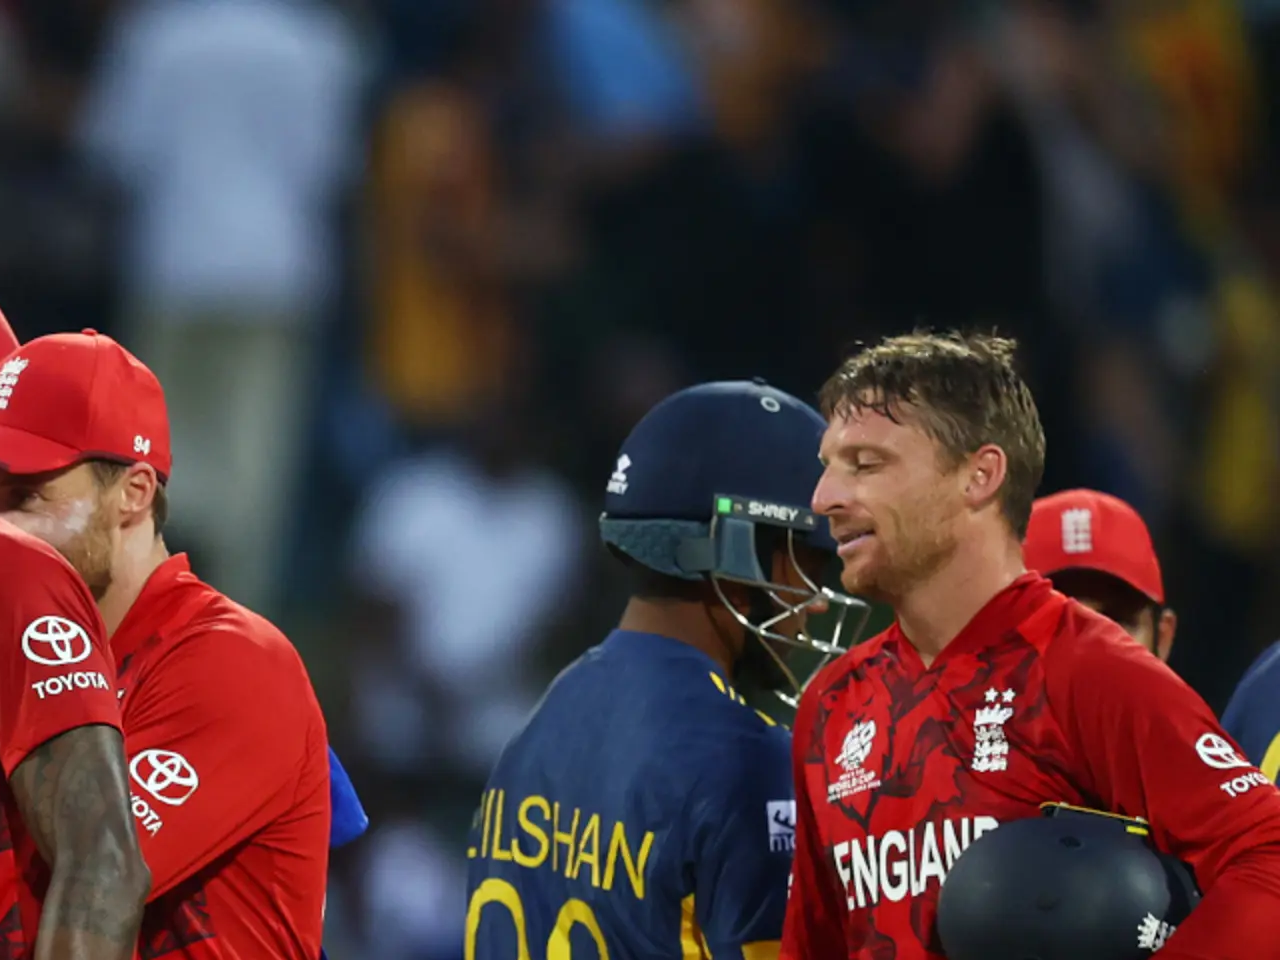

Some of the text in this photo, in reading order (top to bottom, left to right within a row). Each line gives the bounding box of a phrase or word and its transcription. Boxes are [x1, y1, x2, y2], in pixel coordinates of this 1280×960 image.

[134, 435, 151, 456] 94
[748, 501, 799, 522] SHREY
[31, 671, 109, 699] TOYOTA
[466, 788, 654, 900] ILSHAN
